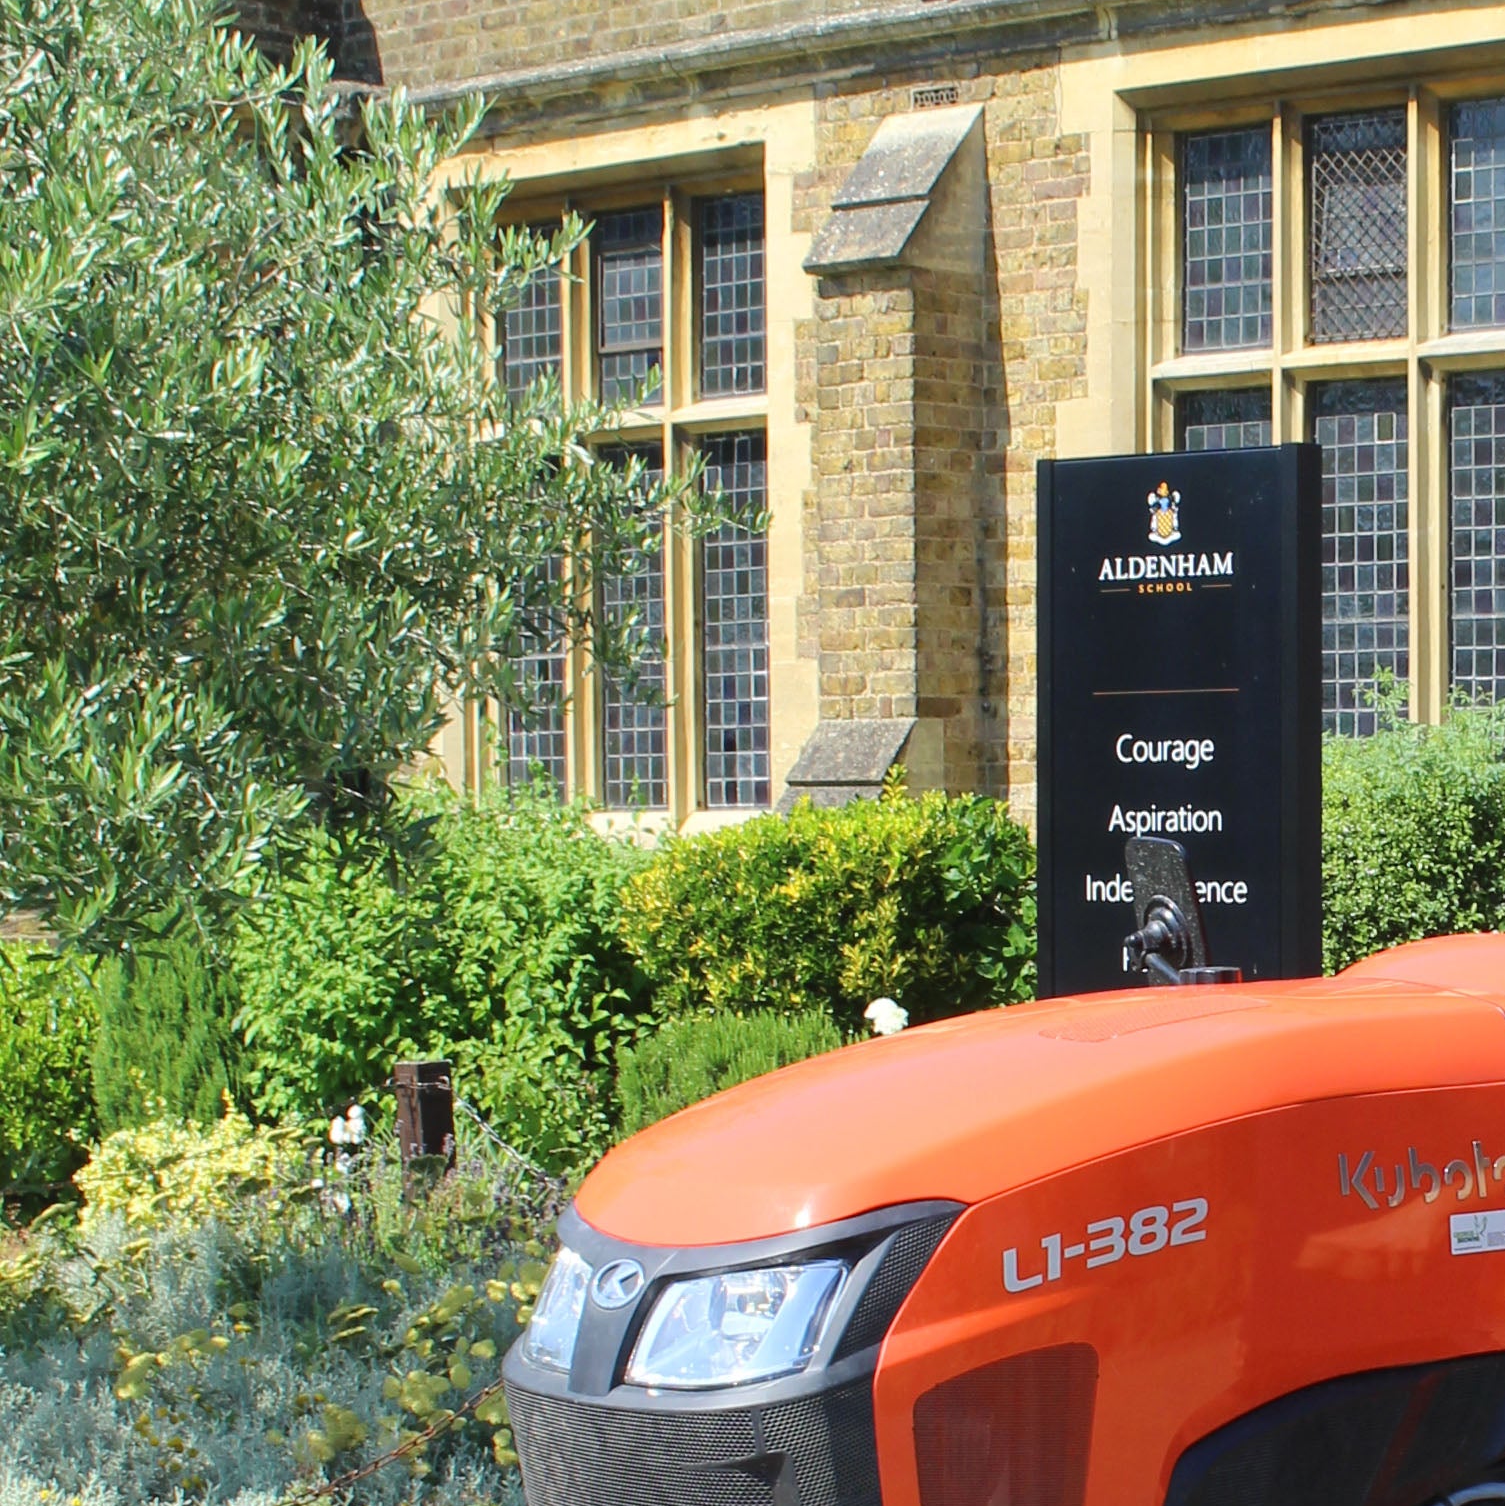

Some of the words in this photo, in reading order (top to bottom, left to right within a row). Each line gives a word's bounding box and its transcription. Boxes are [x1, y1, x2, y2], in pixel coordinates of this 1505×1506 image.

[1099, 551, 1235, 582] ALDENHAM
[1138, 582, 1193, 594] SCHOOL
[1116, 733, 1216, 770] Courage
[1108, 803, 1223, 838] Aspiration
[1085, 873, 1249, 904] Indeence
[1003, 1197, 1209, 1293] L1-382
